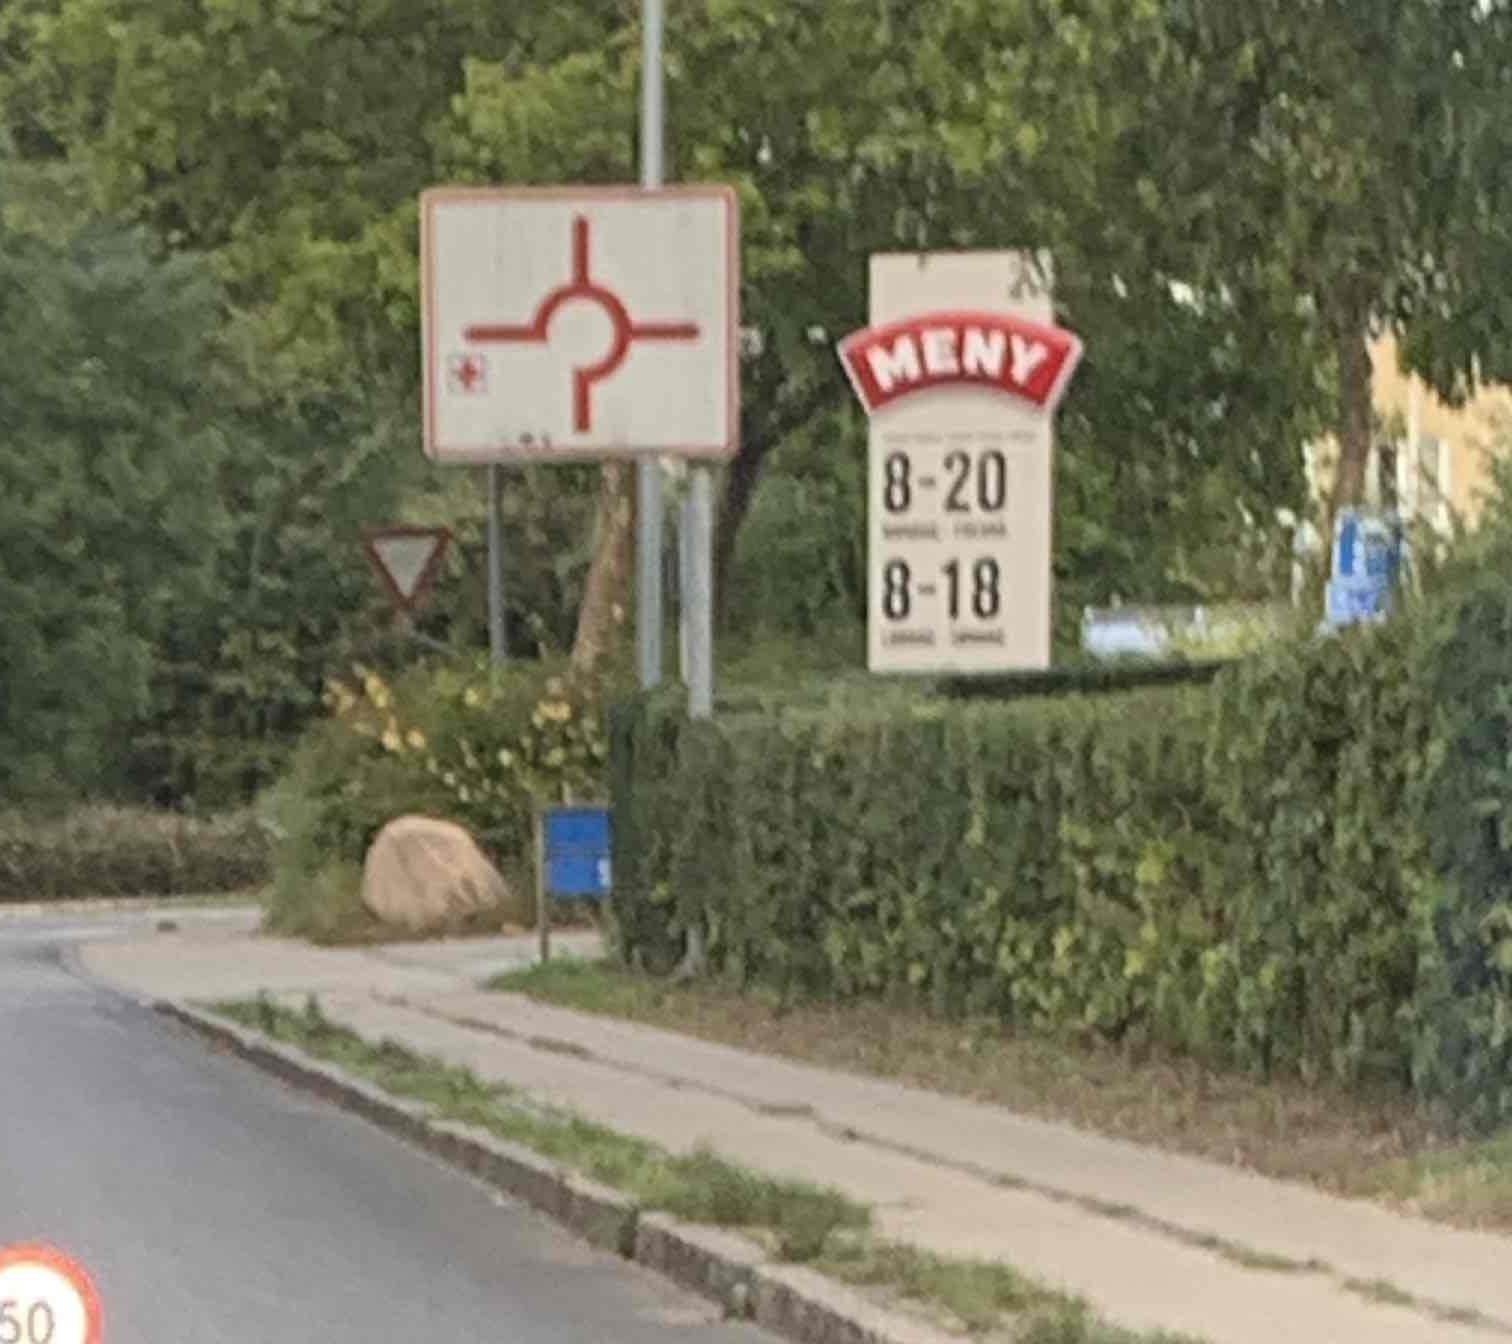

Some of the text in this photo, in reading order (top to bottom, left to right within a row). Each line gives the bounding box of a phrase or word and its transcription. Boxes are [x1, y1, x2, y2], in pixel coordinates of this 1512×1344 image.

[866, 327, 1048, 392] MENY
[884, 450, 1007, 512] 8-20
[883, 558, 1001, 621] 8-18
